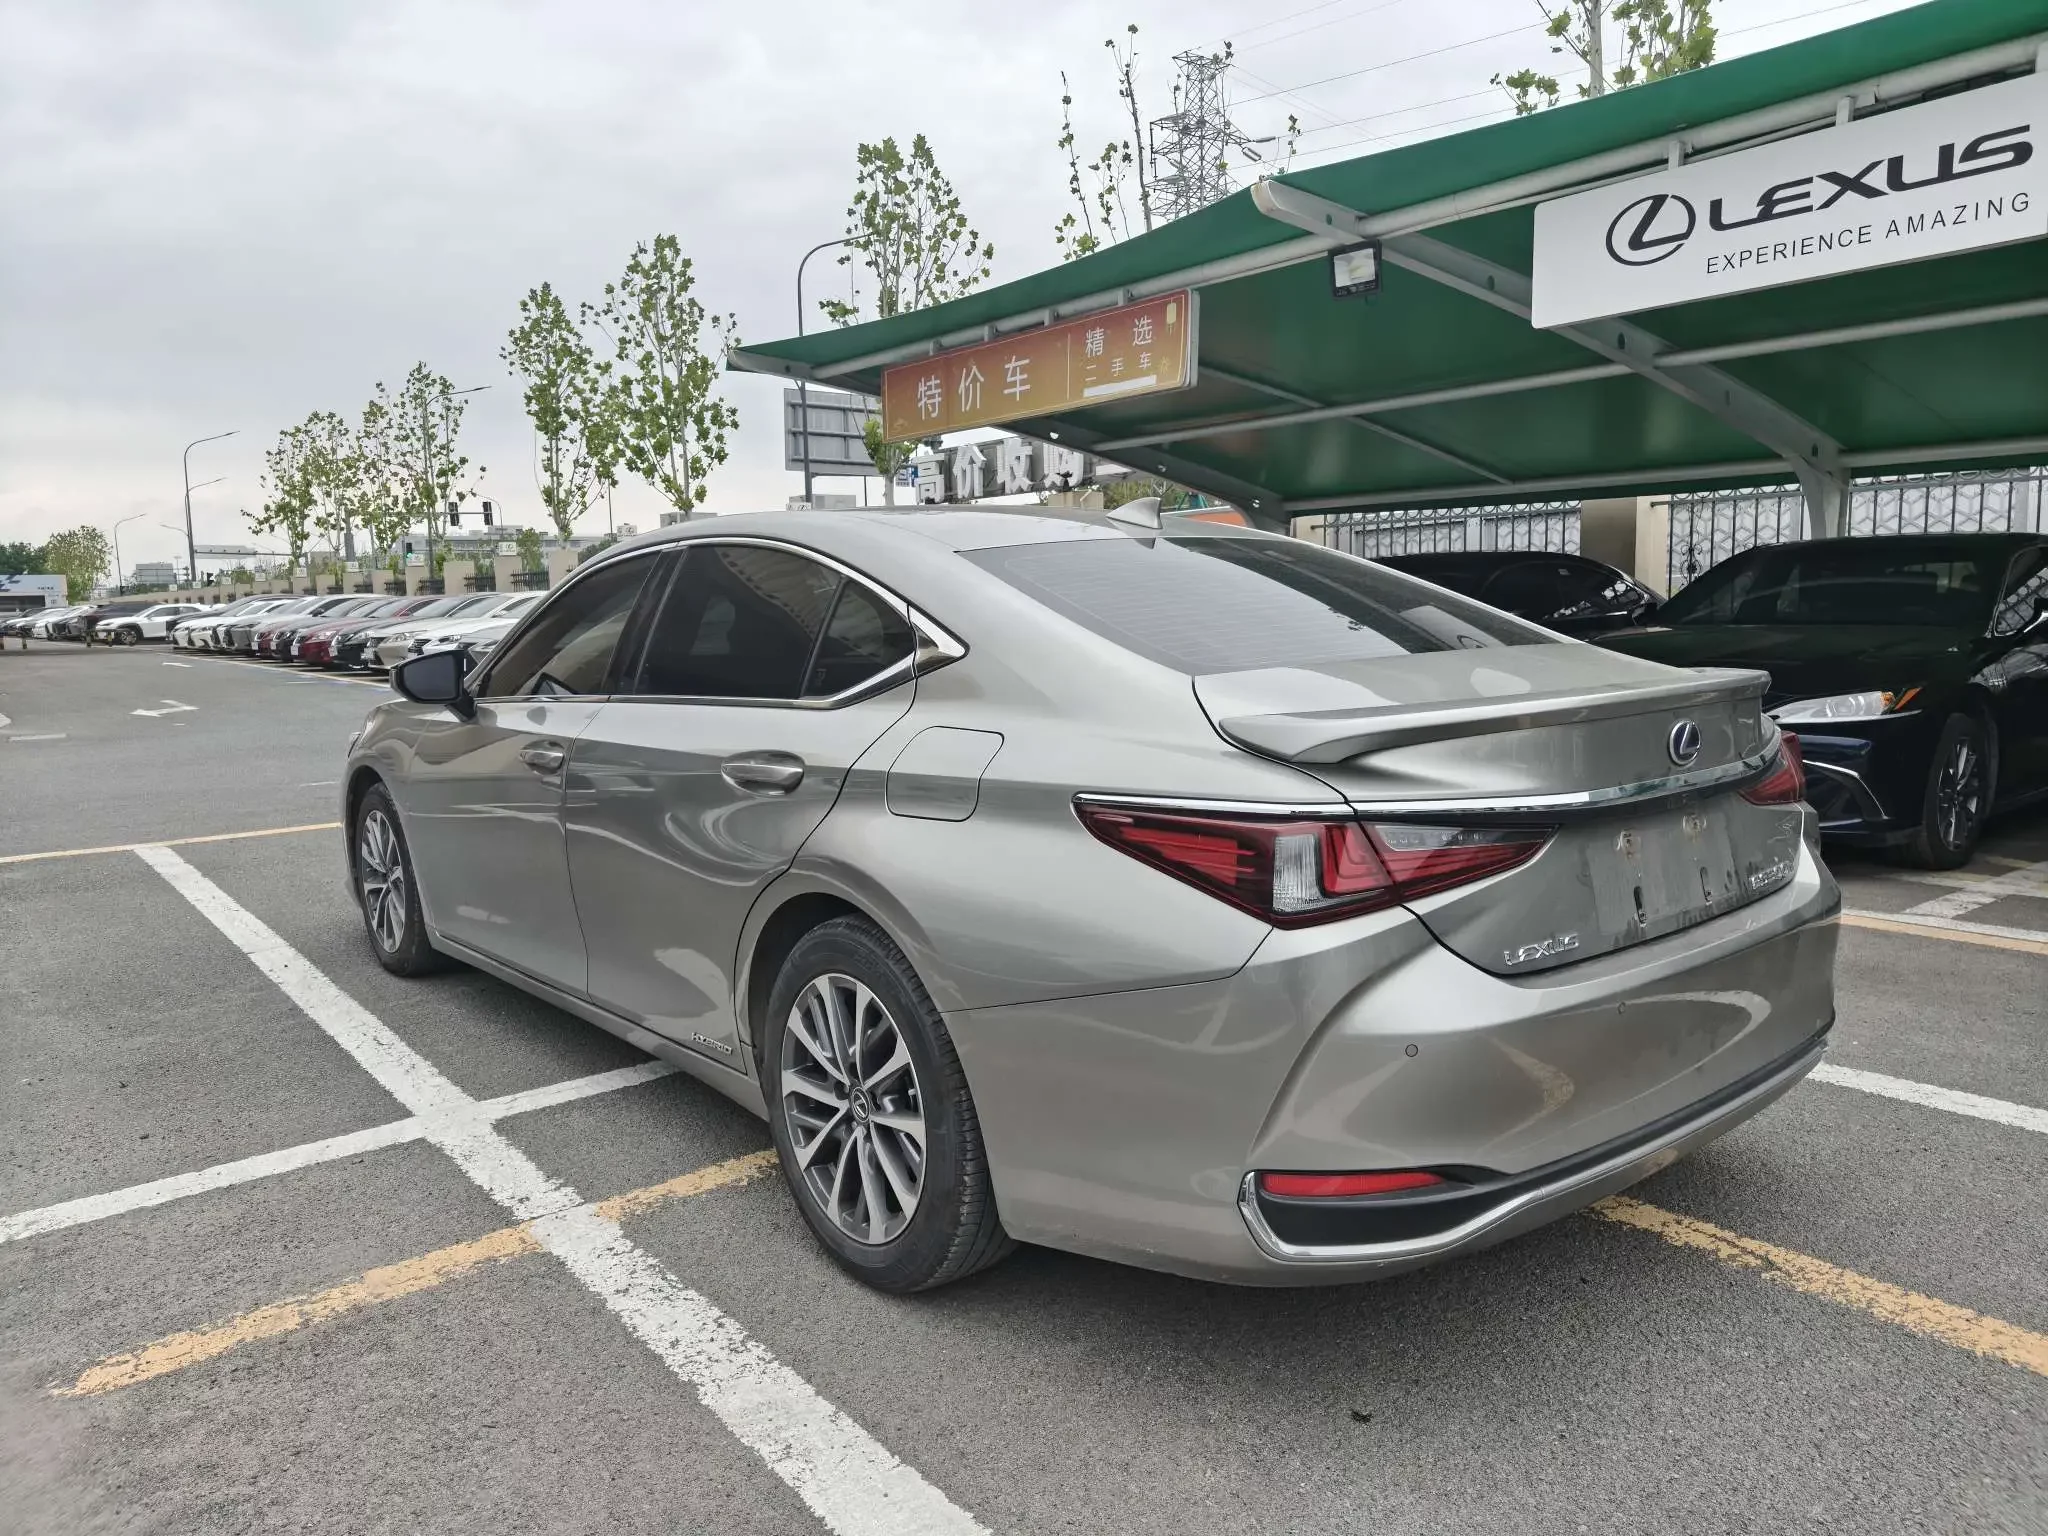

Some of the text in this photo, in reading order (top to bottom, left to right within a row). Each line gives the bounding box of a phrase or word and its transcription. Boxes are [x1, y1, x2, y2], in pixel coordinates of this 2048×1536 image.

[1710, 124, 2033, 231] LEXUS
[1706, 192, 2030, 274] EXPERIENCE AMAZING
[1085, 315, 1153, 358] 精选
[917, 354, 1031, 420] 特价车
[1085, 352, 1152, 381] 二手车
[1503, 933, 1579, 966] LEXUS
